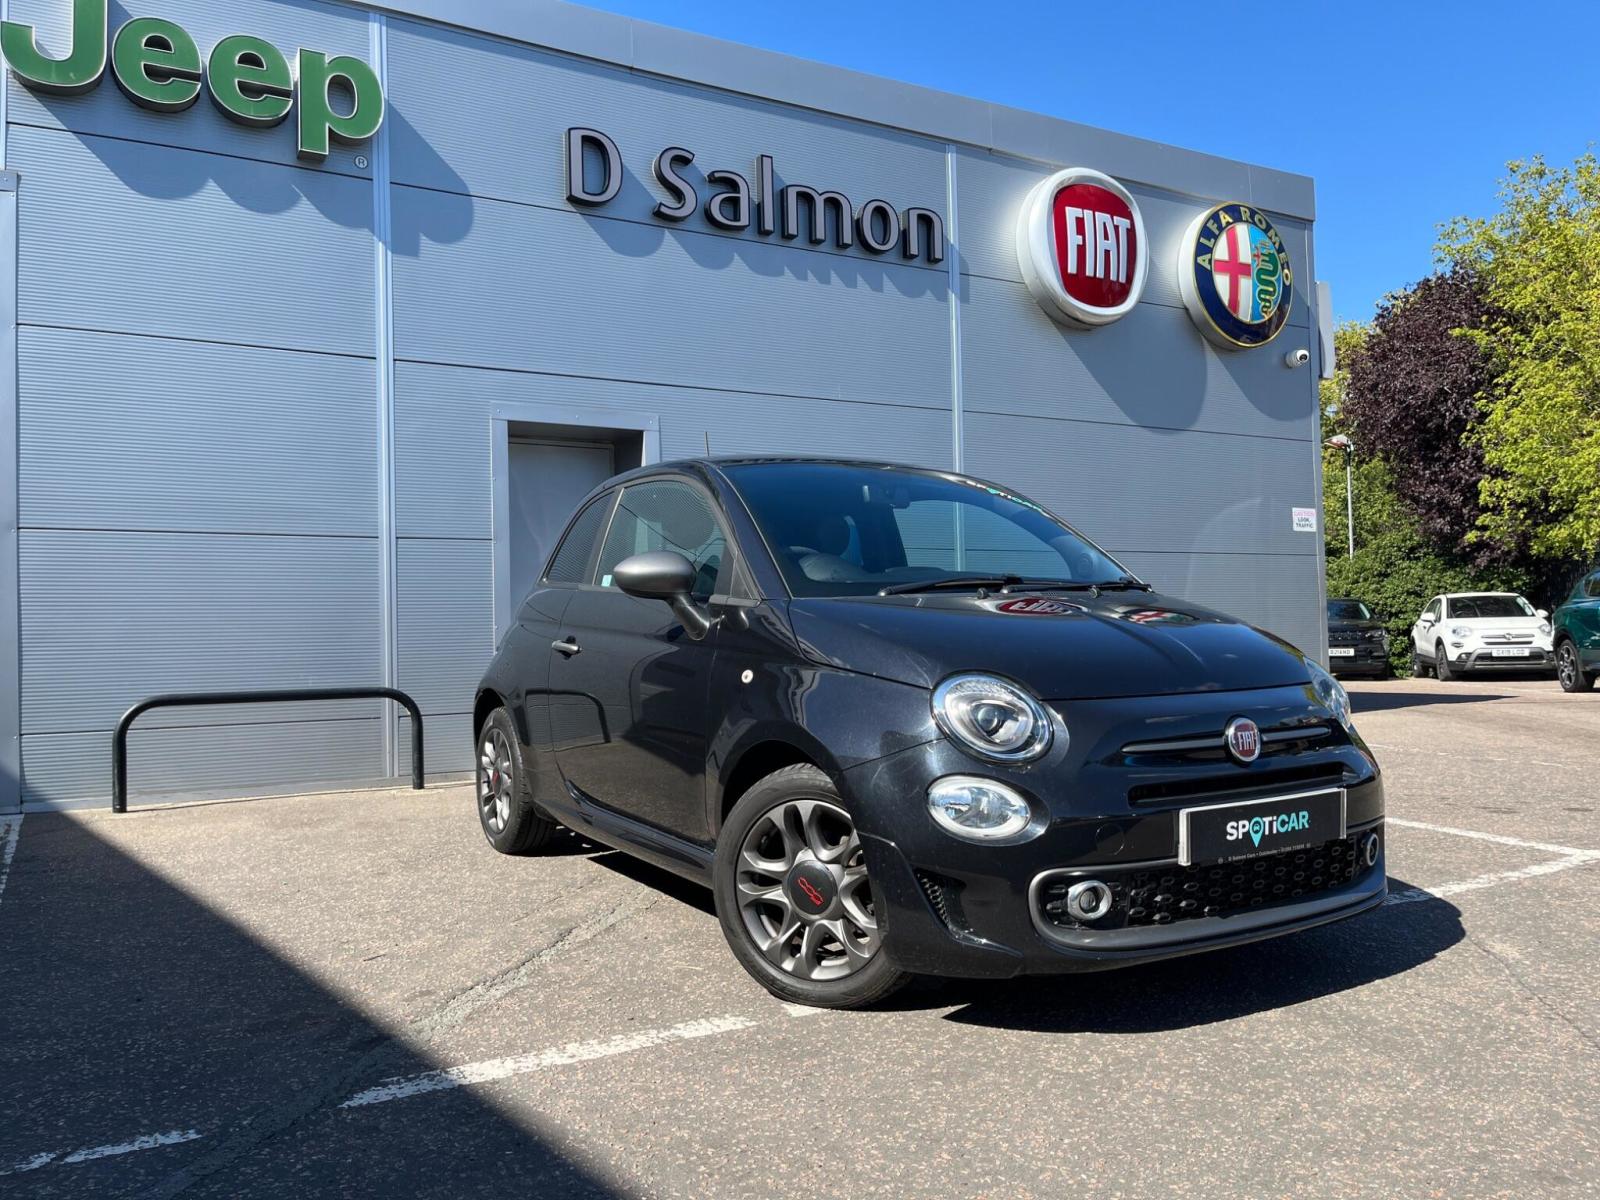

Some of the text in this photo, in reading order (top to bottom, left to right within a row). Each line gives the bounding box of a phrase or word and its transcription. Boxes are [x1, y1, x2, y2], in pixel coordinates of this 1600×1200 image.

[0, 0, 385, 158] Jeep
[566, 127, 944, 263] D Salmon
[1065, 206, 1131, 284] FIAT
[1197, 206, 1291, 286] ALFA ROMEO
[1237, 731, 1257, 750] FIAT
